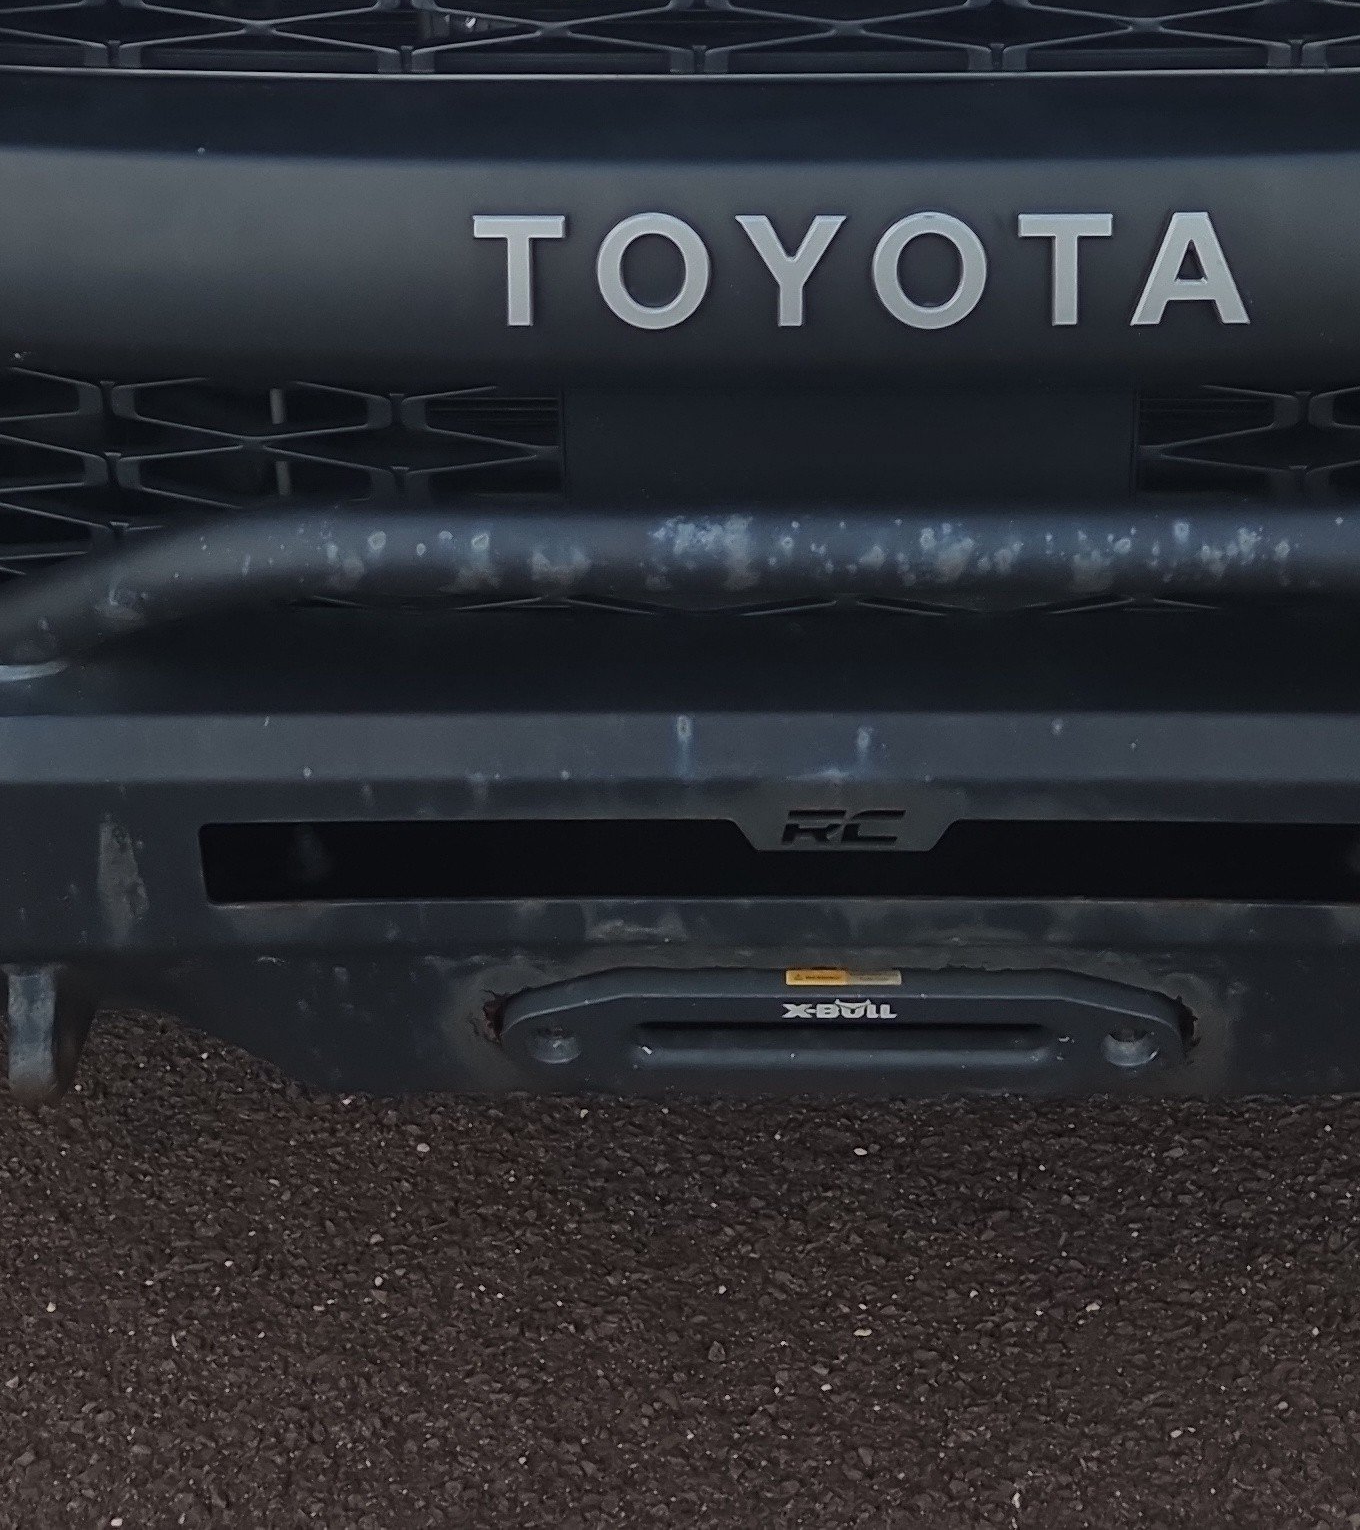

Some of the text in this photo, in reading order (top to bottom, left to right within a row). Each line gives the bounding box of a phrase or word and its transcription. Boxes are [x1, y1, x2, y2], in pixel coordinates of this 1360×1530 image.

[472, 212, 1251, 330] TOYOTA
[781, 809, 907, 844] RC
[782, 999, 898, 1019] X-BULL
